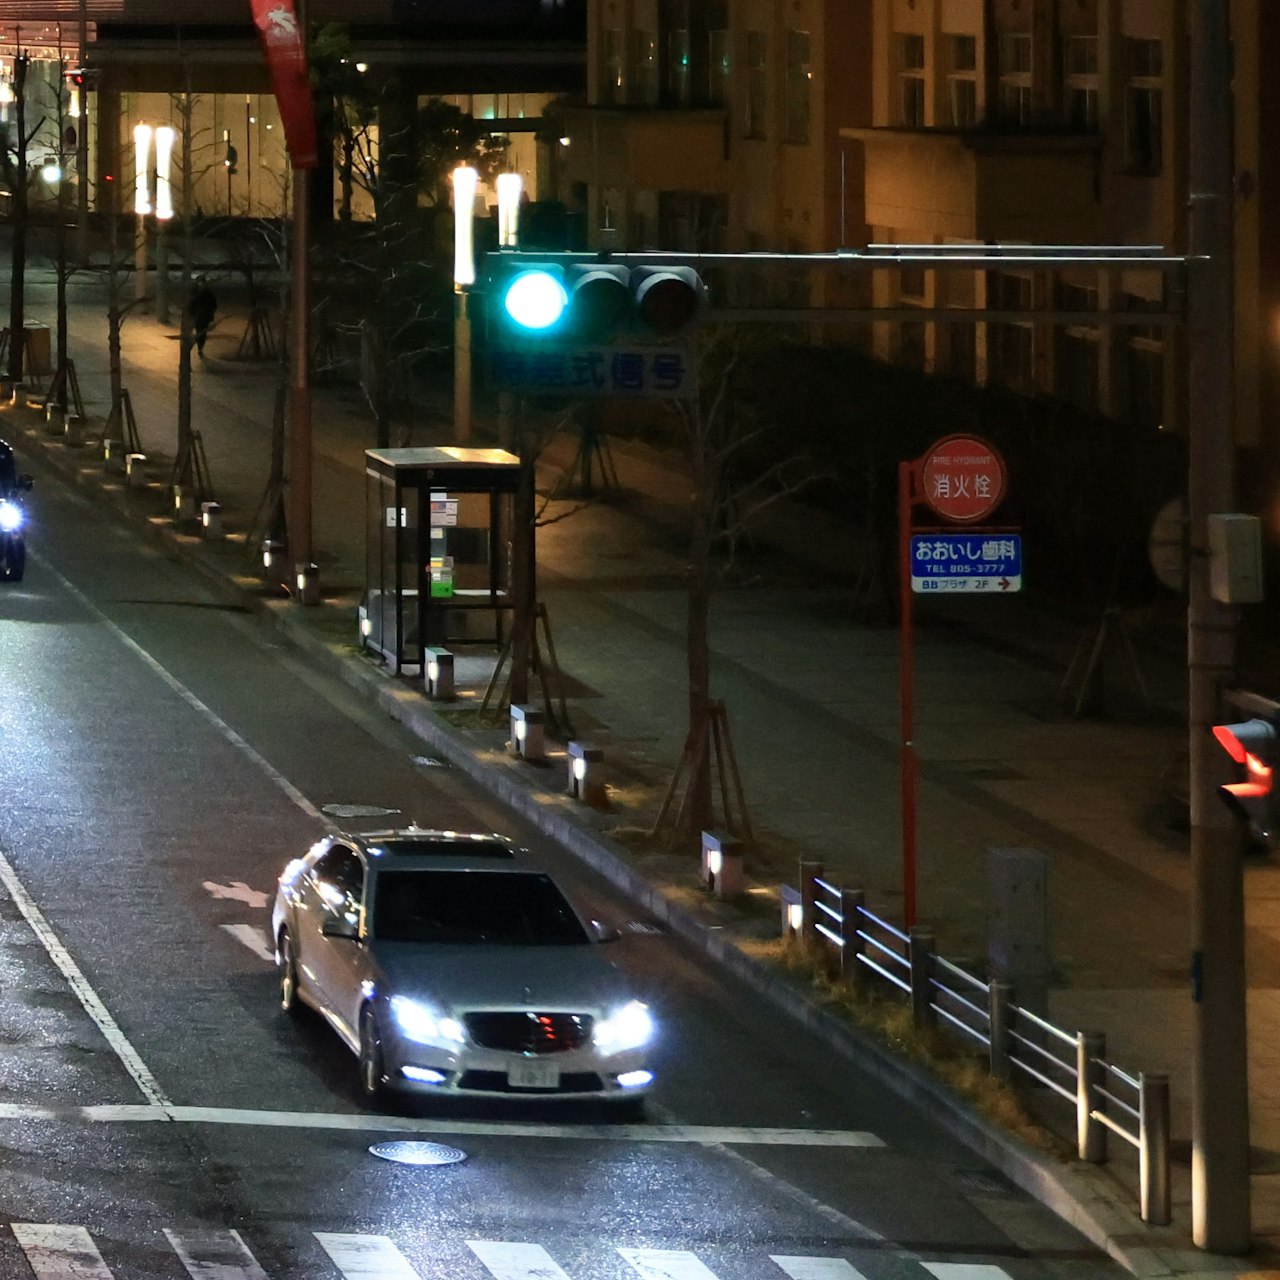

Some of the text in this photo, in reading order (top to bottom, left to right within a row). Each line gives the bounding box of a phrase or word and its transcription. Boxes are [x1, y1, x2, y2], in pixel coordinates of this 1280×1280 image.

[933, 474, 991, 498] 消火栓
[915, 540, 1016, 561] おおいし歯科
[925, 564, 946, 573] TEL
[975, 579, 990, 590] 2F
